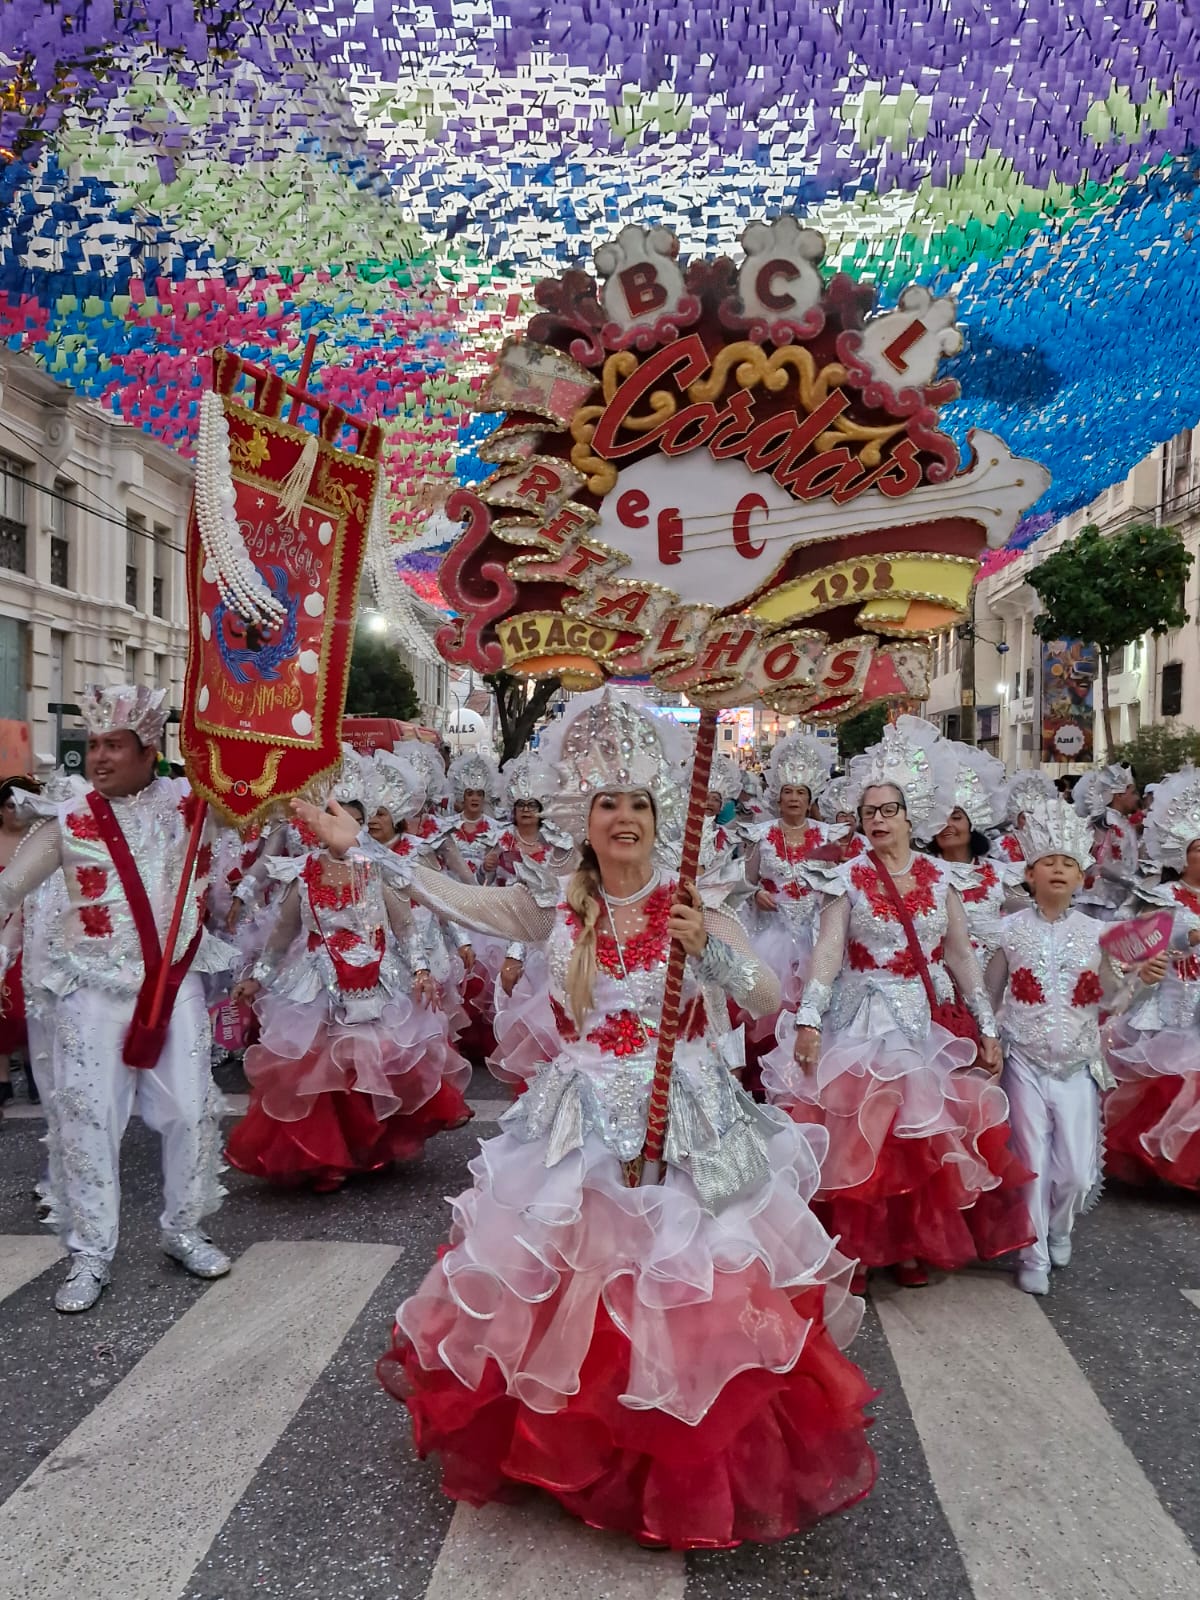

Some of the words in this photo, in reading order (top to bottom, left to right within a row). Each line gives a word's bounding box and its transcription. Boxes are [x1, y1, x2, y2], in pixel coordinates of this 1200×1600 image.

[591, 333, 922, 505] Cordas
[810, 561, 894, 604] 1998
[506, 619, 541, 653] 15
[1057, 736, 1074, 744] Azul
